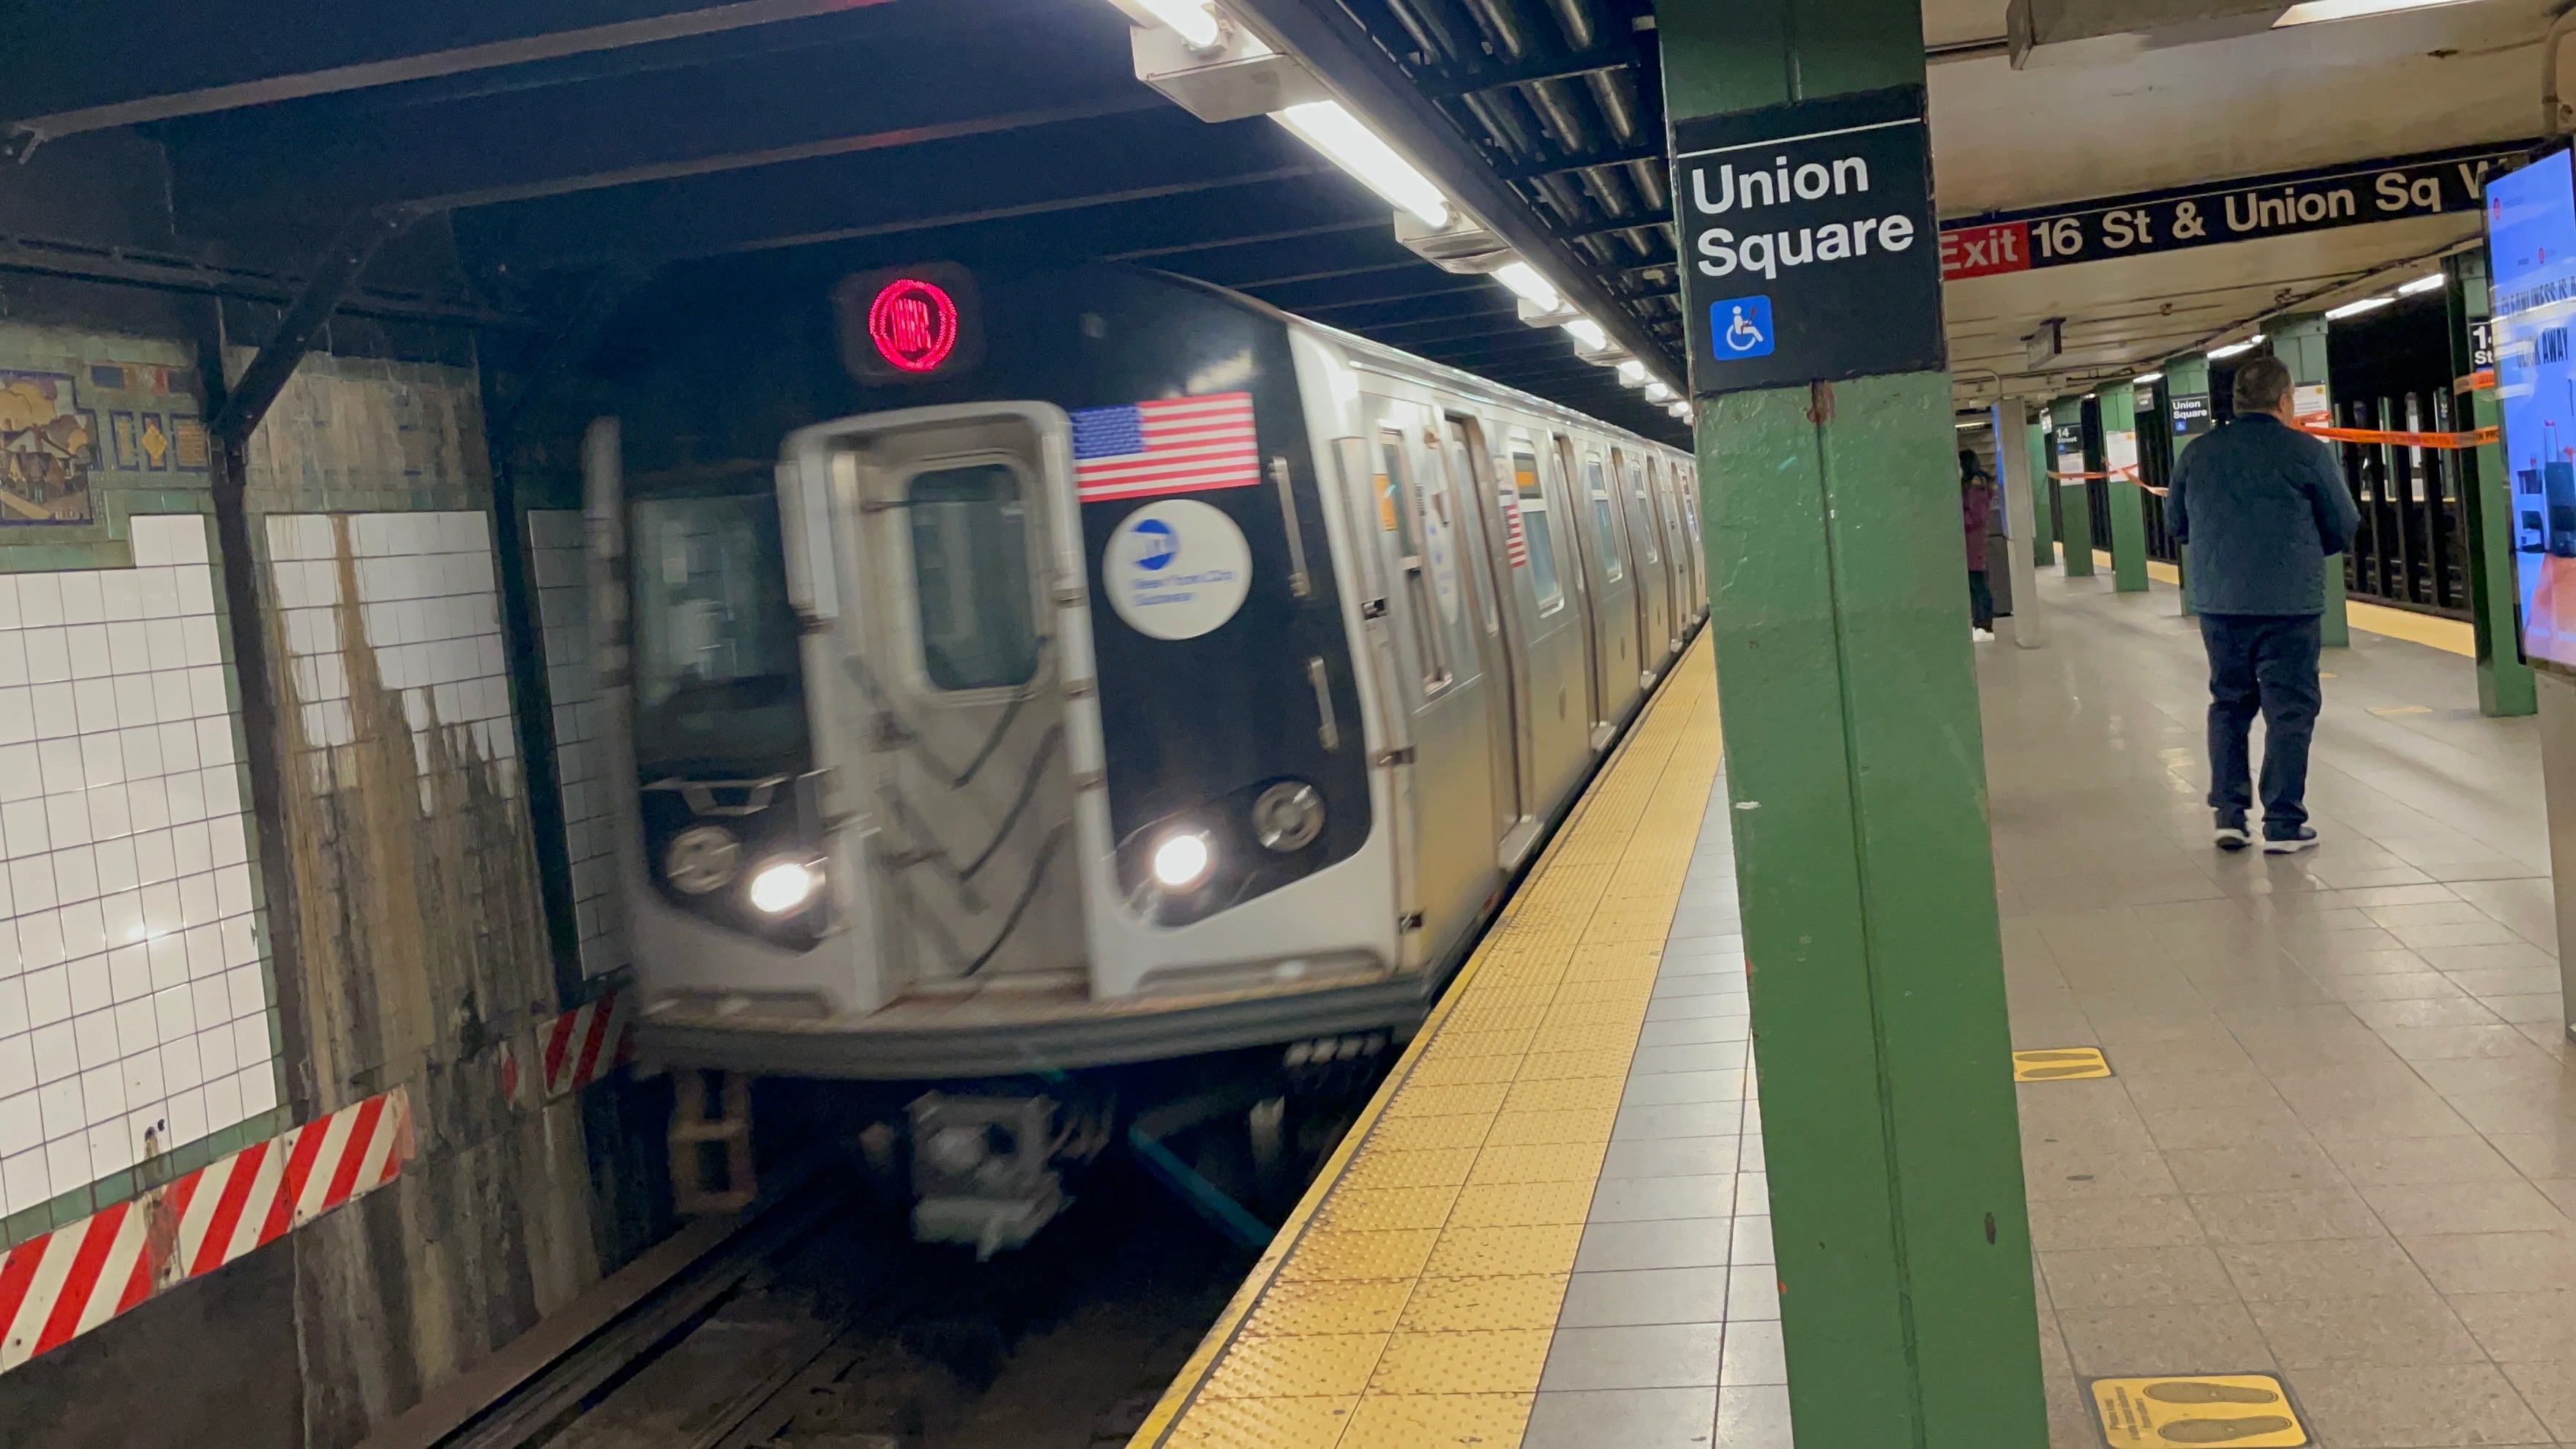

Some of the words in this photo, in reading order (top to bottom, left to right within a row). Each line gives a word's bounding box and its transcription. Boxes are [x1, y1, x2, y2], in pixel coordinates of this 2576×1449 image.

[1692, 155, 1868, 214] Union
[1939, 228, 2018, 271] Exit
[2032, 218, 2083, 258] 16
[2102, 211, 2153, 249] St
[2172, 201, 2206, 239] &
[2225, 187, 2356, 232] Union
[2375, 172, 2443, 213] Sq
[1698, 214, 1914, 280] Square
[2473, 326, 2492, 349] 1
[2474, 351, 2493, 364] St
[2173, 400, 2201, 410] Union
[2173, 408, 2208, 420] Square
[2056, 427, 2070, 438] 14
